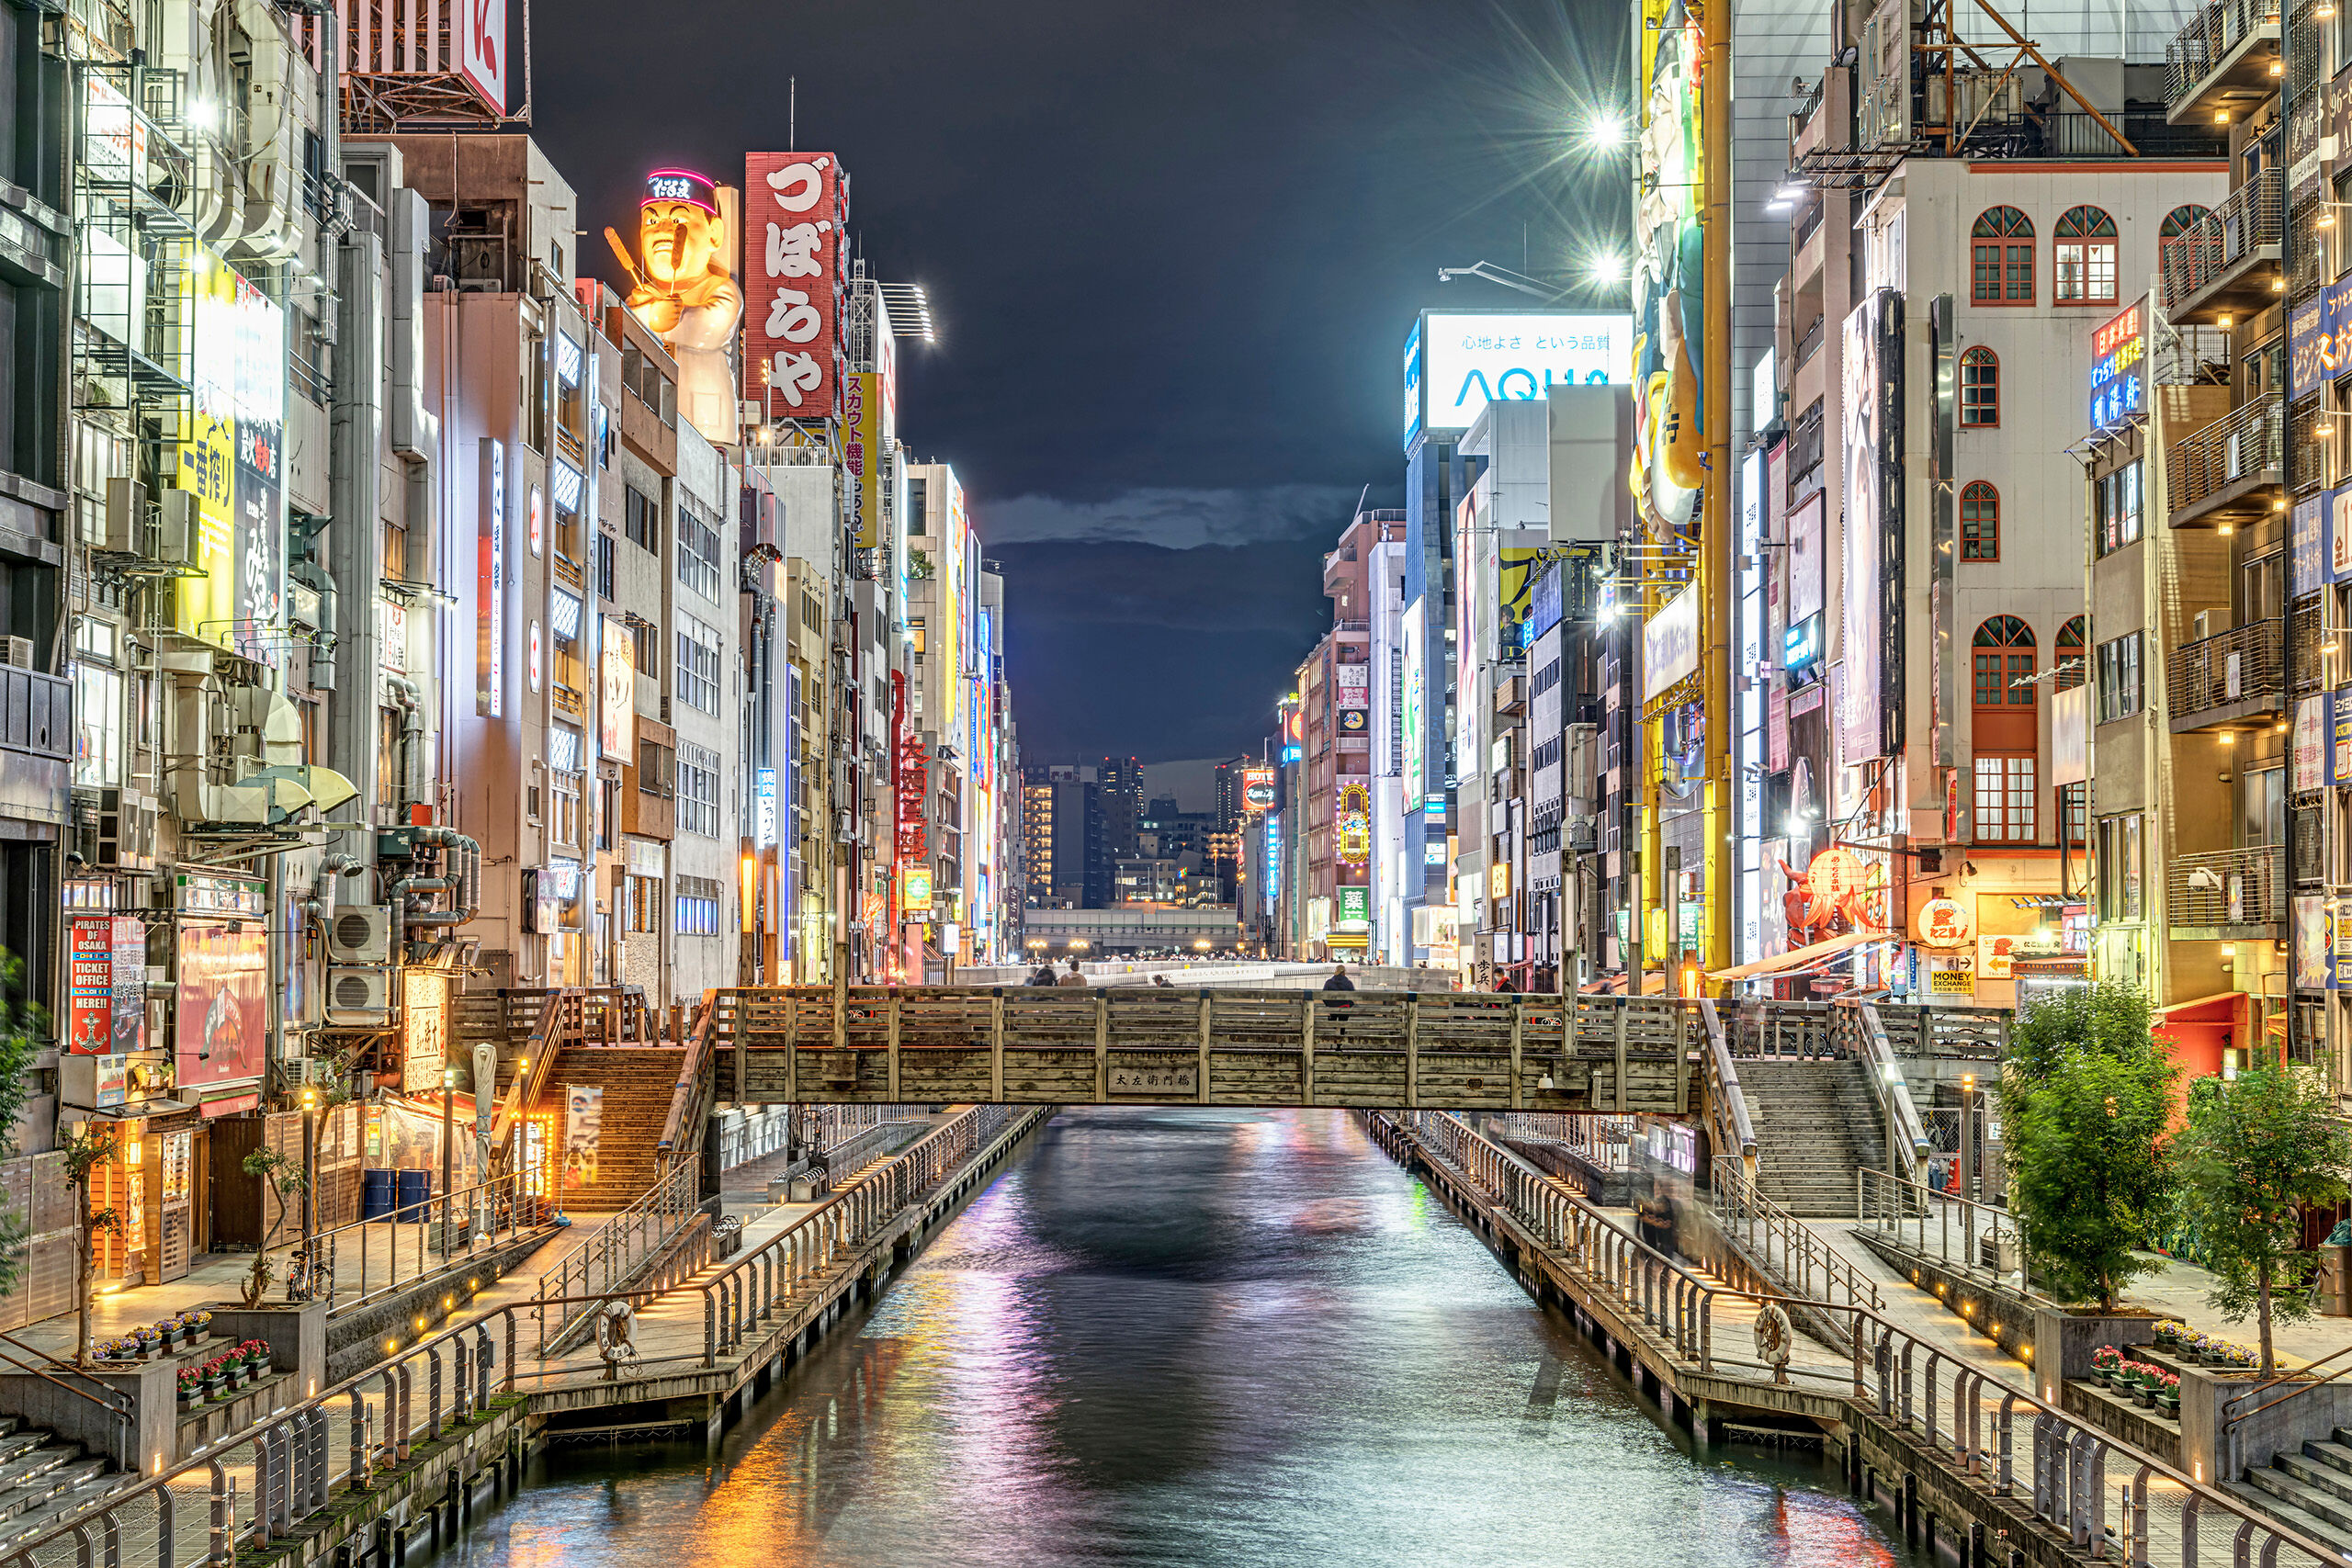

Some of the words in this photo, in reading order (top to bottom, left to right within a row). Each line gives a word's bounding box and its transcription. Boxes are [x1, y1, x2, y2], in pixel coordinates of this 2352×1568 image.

[765, 156, 831, 408] づぼらや
[1461, 335, 1522, 350] 心地よさ
[1535, 335, 1611, 350] という品質
[184, 439, 231, 508] 一番搾り
[763, 770, 775, 796] 焼肉
[763, 798, 774, 843] いろりや
[1344, 890, 1363, 909] 薬
[74, 920, 110, 930] PIRATES
[87, 931, 98, 940] OF
[77, 941, 107, 951] OSAKA
[74, 963, 109, 974] TICKET
[1477, 959, 1490, 986] 歩兵
[75, 975, 108, 986] OFFICE
[1933, 972, 1971, 981] MONEY
[75, 998, 107, 1009] HERE!!
[1116, 1074, 1190, 1086] 太左衛門橋
